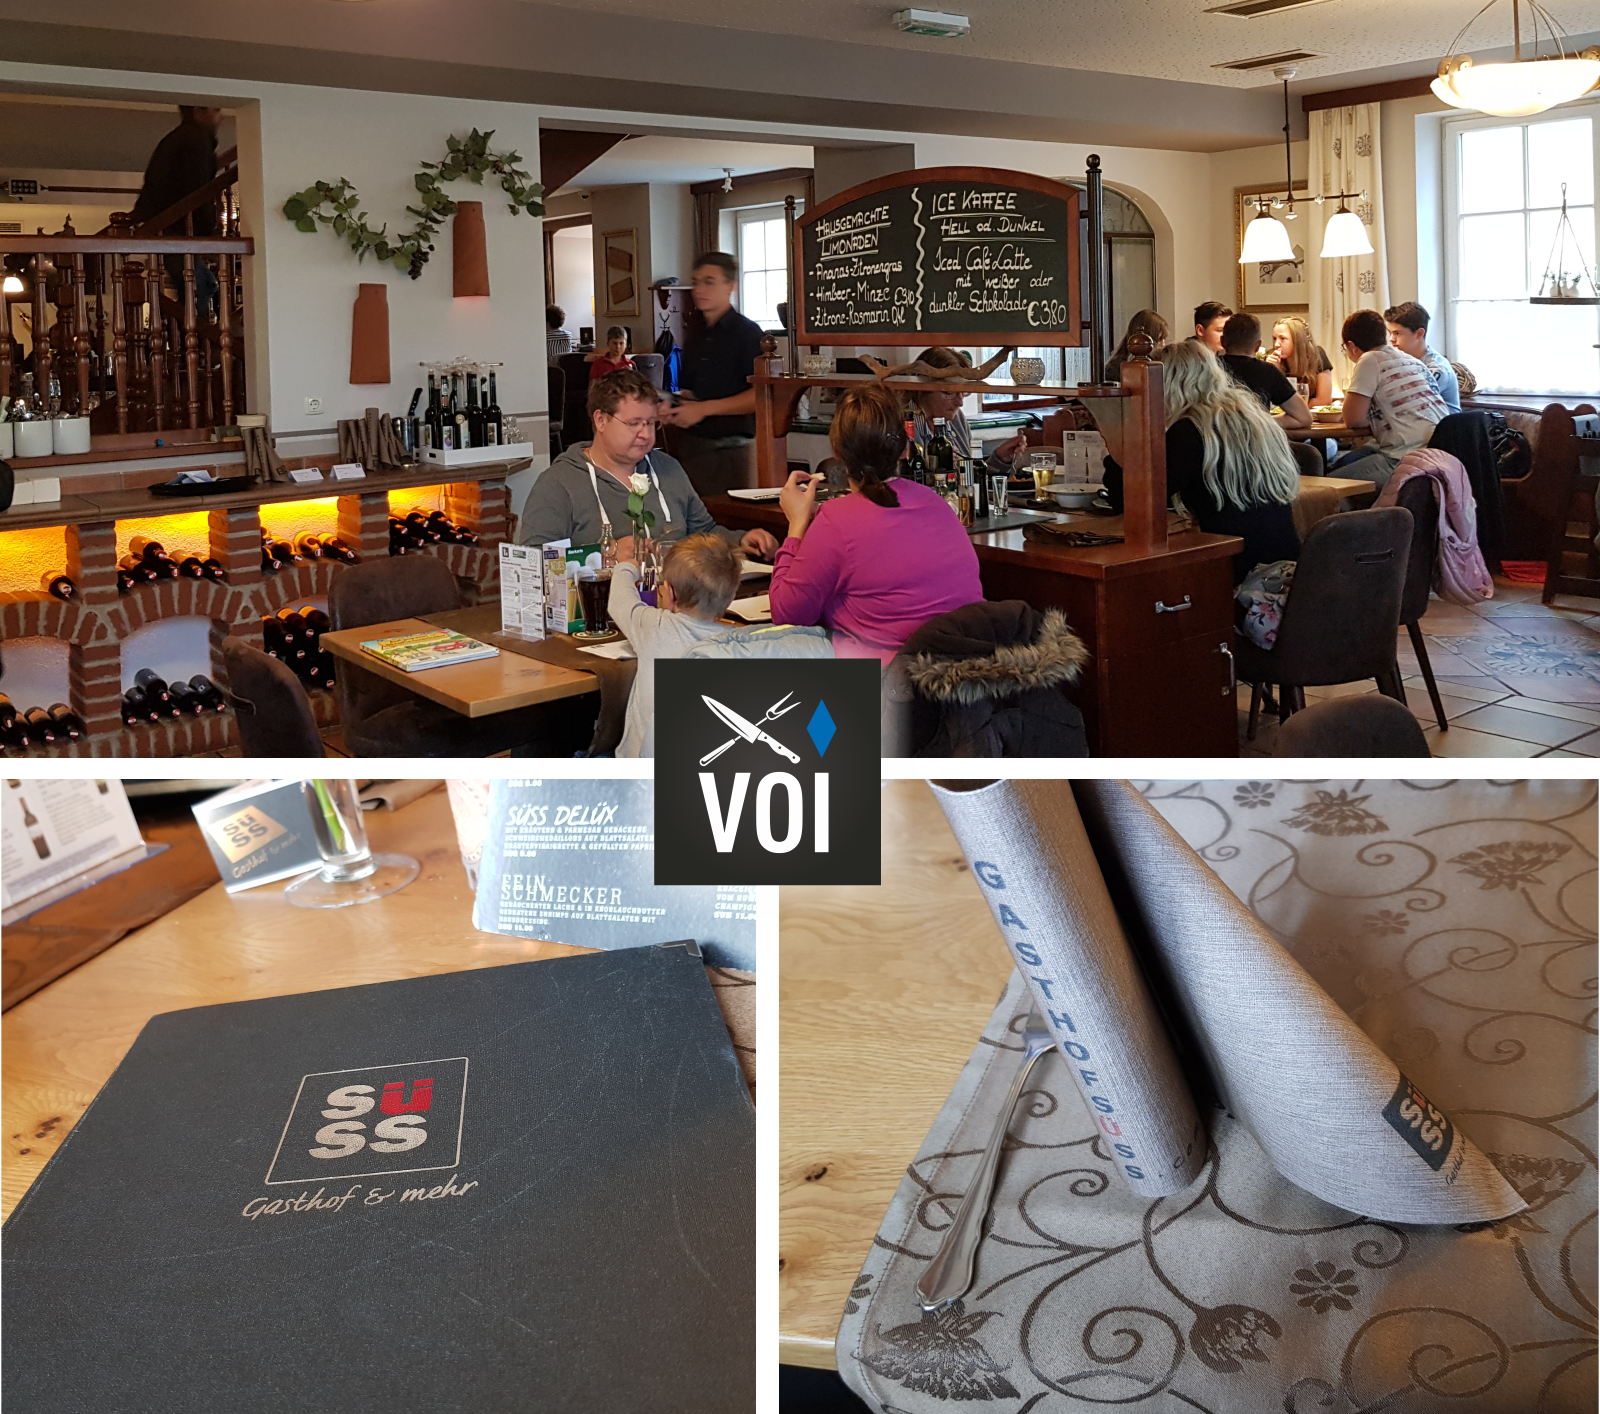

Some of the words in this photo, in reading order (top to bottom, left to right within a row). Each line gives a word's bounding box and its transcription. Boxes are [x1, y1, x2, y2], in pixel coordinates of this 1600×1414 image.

[932, 192, 957, 214] ICE
[962, 190, 1018, 210] KAFFEE
[815, 205, 890, 237] HAUSGEMACHTE
[941, 218, 971, 235] HELL
[996, 216, 1045, 233] DUNKEL
[821, 228, 879, 256] LIMONADEN
[932, 246, 961, 271] Iced
[991, 243, 1033, 270] Latte
[956, 272, 972, 288] mit
[985, 273, 1020, 289] weißer
[1029, 270, 1054, 288] oder
[929, 290, 966, 313] dunkler
[968, 290, 1028, 313] Schokolade
[505, 803, 549, 827] SÜSS
[554, 801, 619, 827] DELÜX
[501, 885, 623, 906] SCHMECKER
[242, 1184, 362, 1221] Gasthof
[364, 1187, 396, 1205] &
[400, 1174, 479, 1203] mehr
